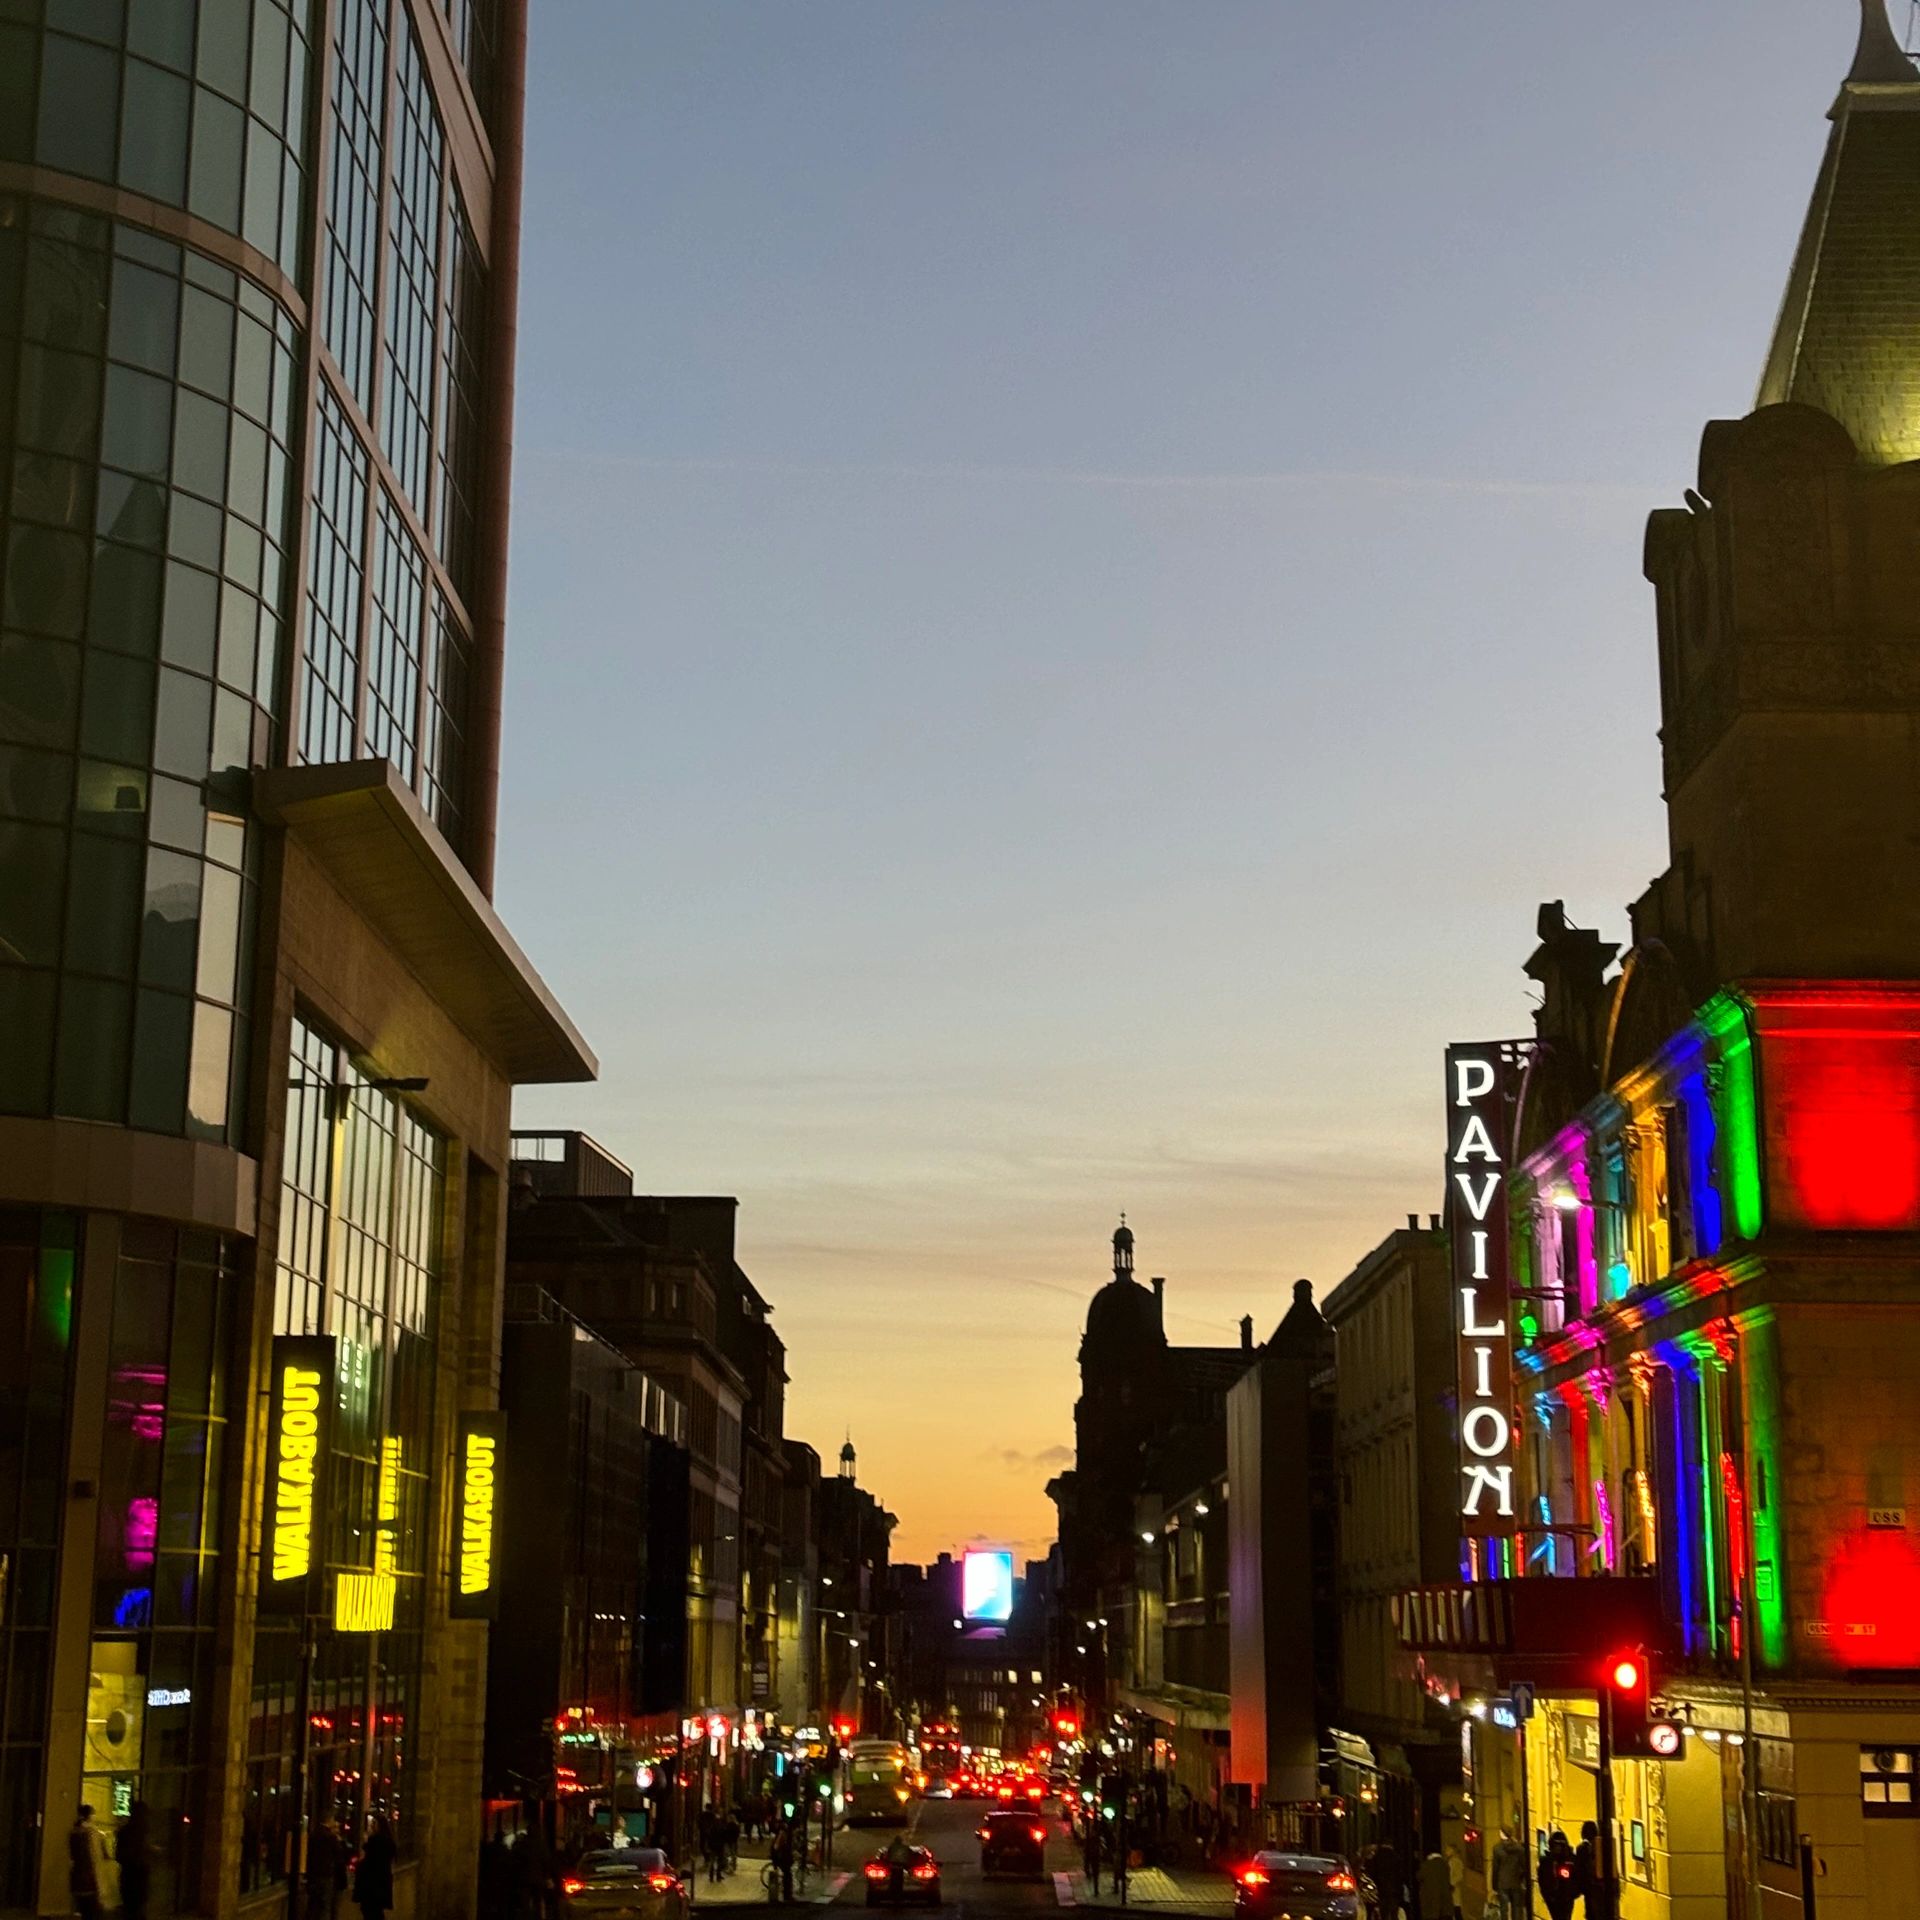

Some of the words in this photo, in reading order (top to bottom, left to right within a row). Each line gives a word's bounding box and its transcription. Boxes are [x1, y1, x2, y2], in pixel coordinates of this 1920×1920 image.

[1453, 1059, 1515, 1518] PAVILION
[273, 1366, 321, 1581] WALKABOUT
[460, 1434, 496, 1594] WALKABOUT
